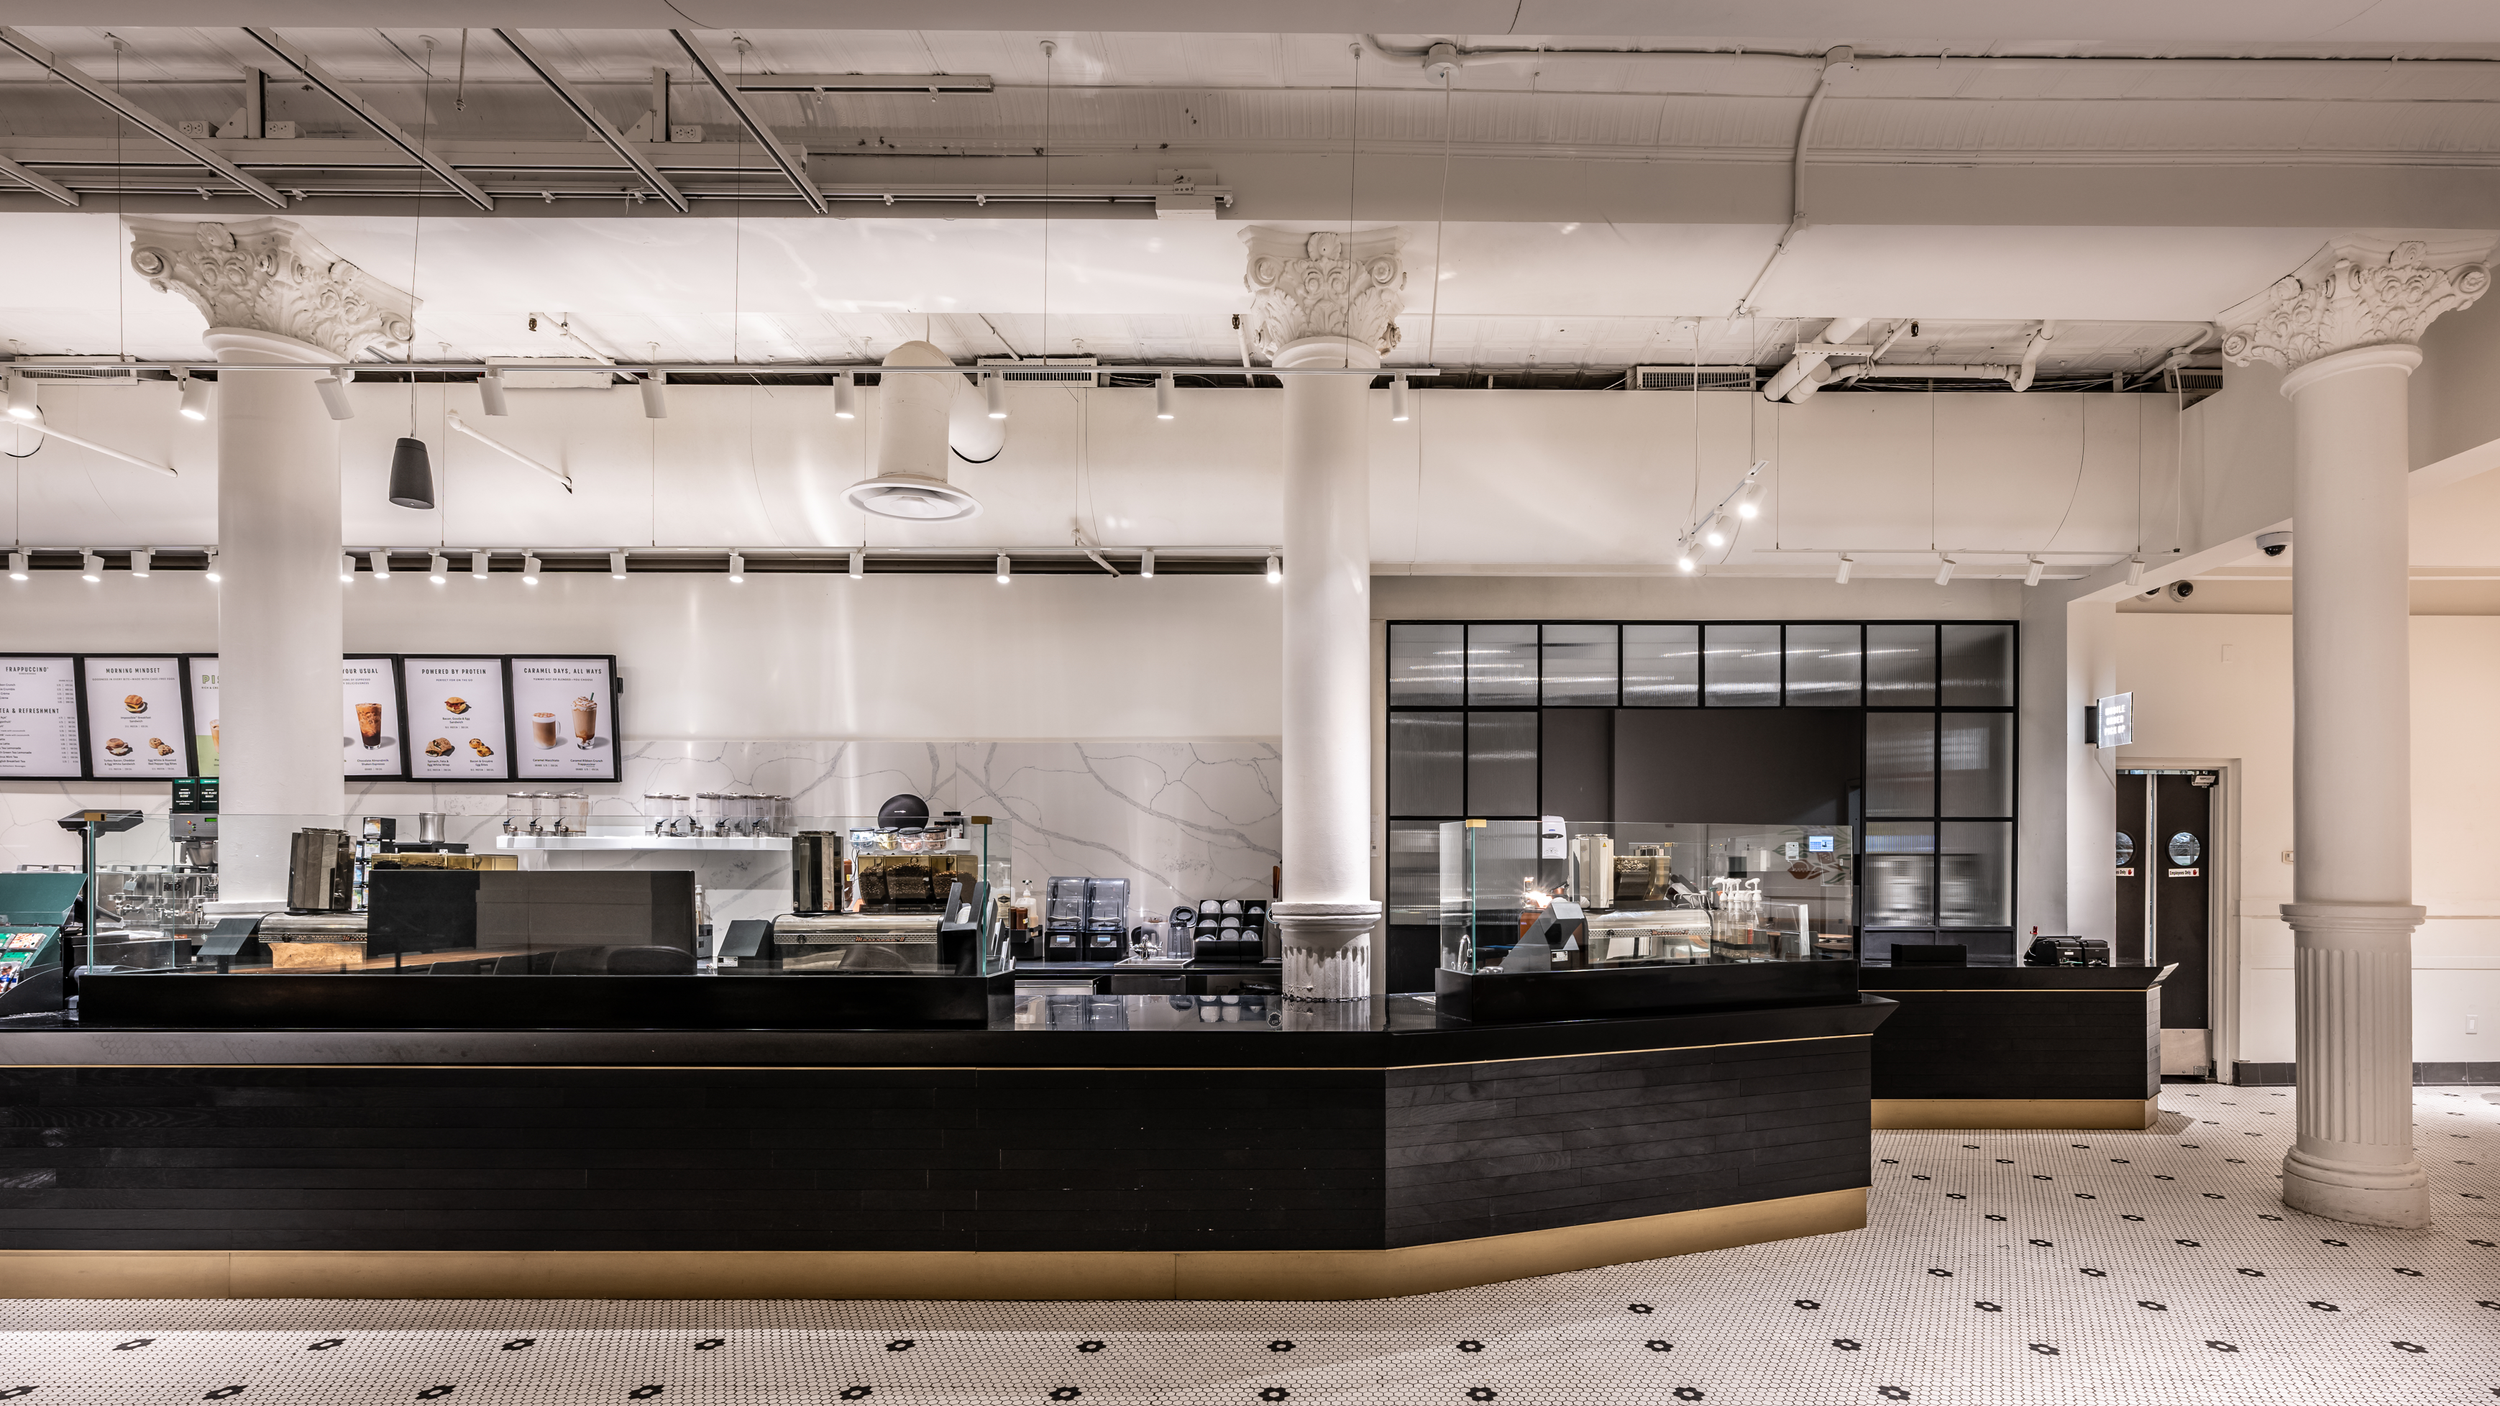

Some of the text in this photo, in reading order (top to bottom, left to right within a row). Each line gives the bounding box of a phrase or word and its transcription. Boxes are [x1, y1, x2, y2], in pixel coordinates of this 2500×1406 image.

[2105, 704, 2126, 716] MOBILE
[2106, 715, 2124, 726] ORDER
[2104, 725, 2126, 736] PICK UP
